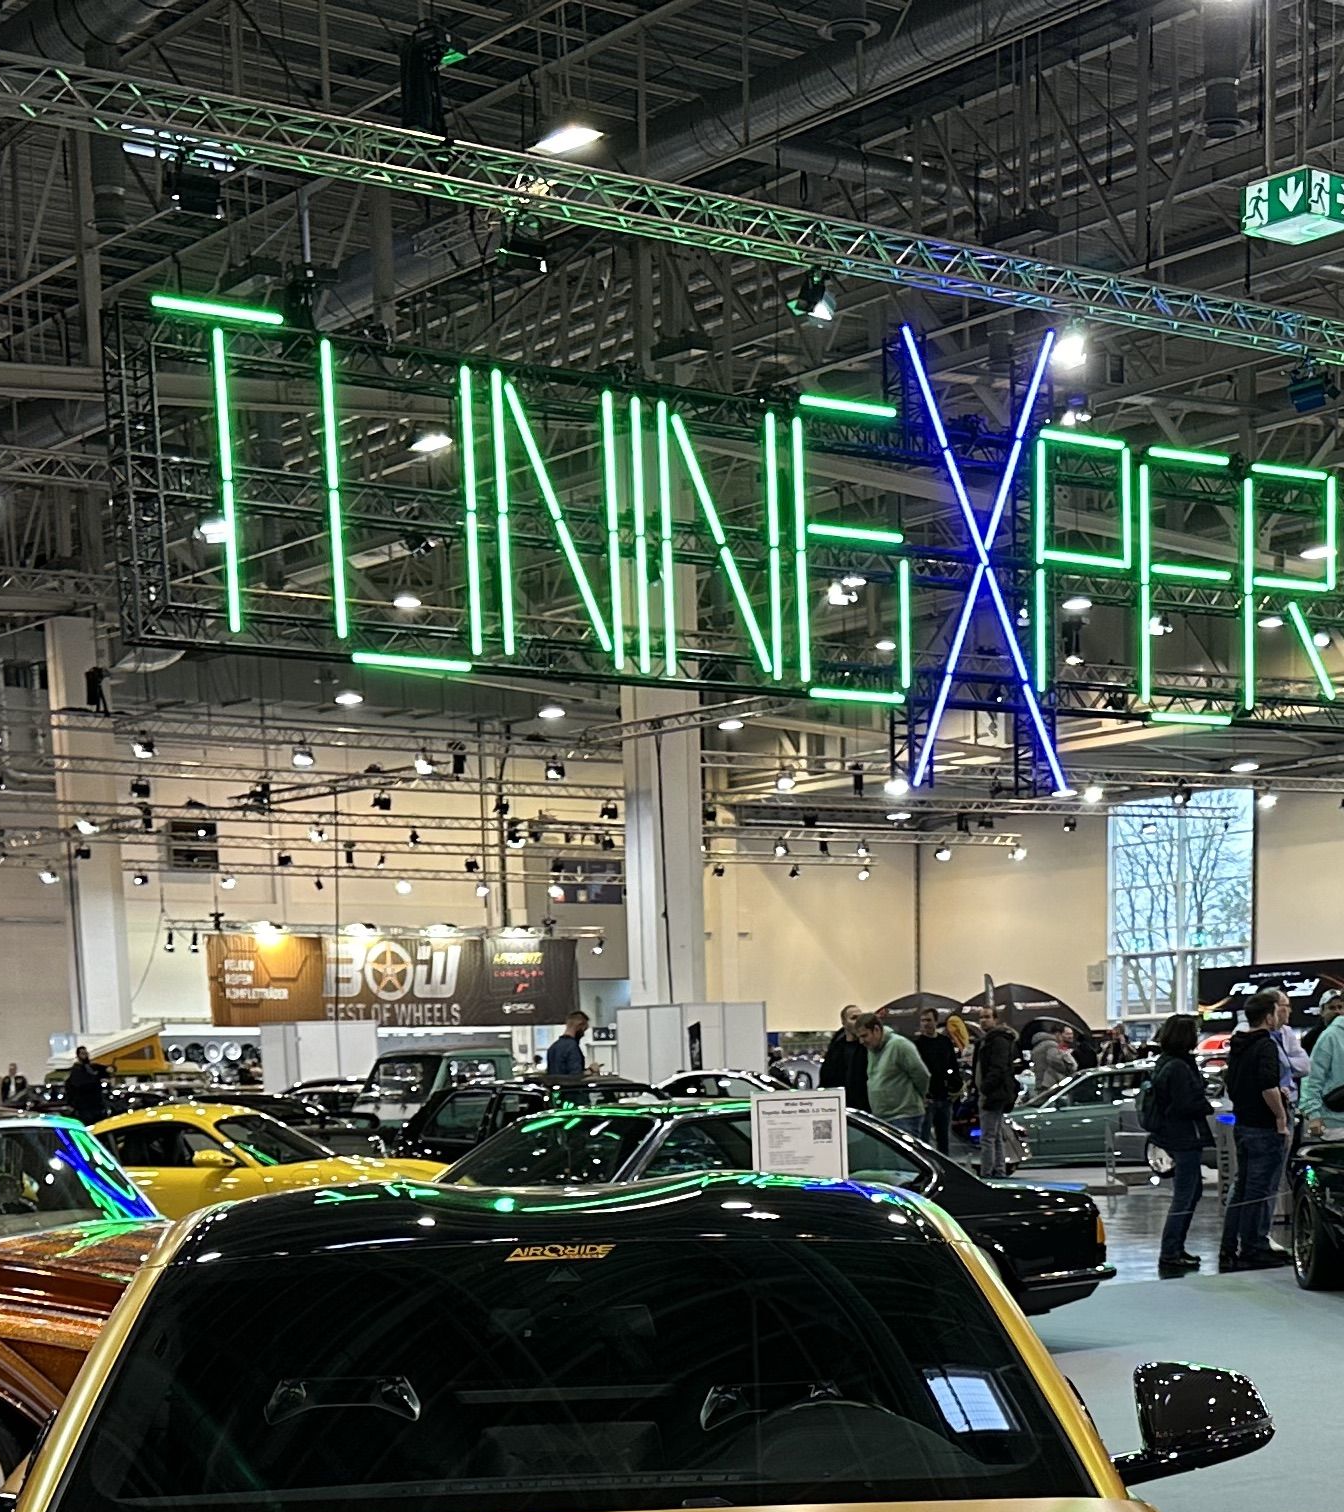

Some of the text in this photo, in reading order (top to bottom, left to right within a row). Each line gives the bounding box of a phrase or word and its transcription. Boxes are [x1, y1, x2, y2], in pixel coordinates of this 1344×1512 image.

[152, 295, 910, 705] TUNING
[326, 1003, 462, 1026] BEST OF WHEELS
